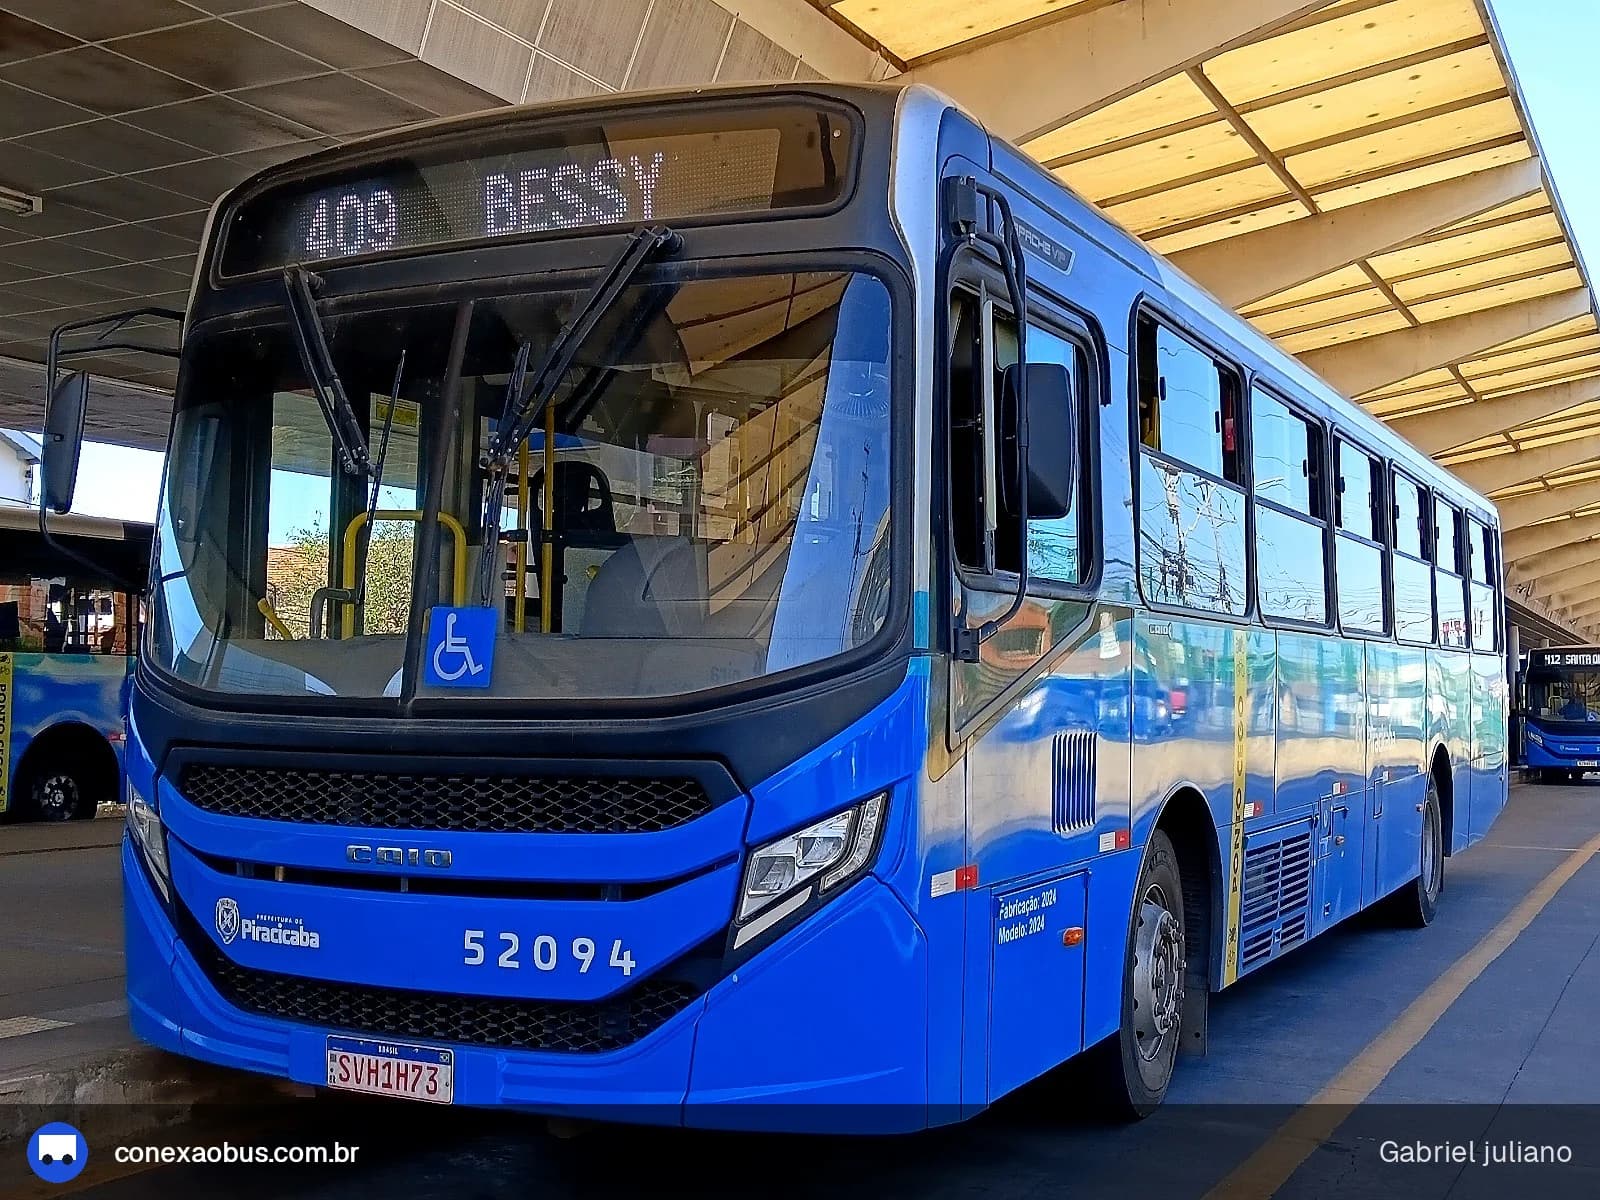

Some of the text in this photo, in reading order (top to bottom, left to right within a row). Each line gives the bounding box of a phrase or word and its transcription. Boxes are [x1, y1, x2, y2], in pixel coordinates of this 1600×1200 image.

[305, 152, 663, 258] 409 BESSY
[1544, 654, 1561, 665] 412
[346, 845, 452, 868] CAIO
[999, 888, 1056, 920] Fabricação: 2024
[241, 918, 320, 948] Piracicaba
[998, 914, 1044, 944] Modelo: 2024
[463, 929, 636, 976] 52094
[378, 1045, 399, 1055] BRASIL
[338, 1054, 439, 1095] SVH1H73
